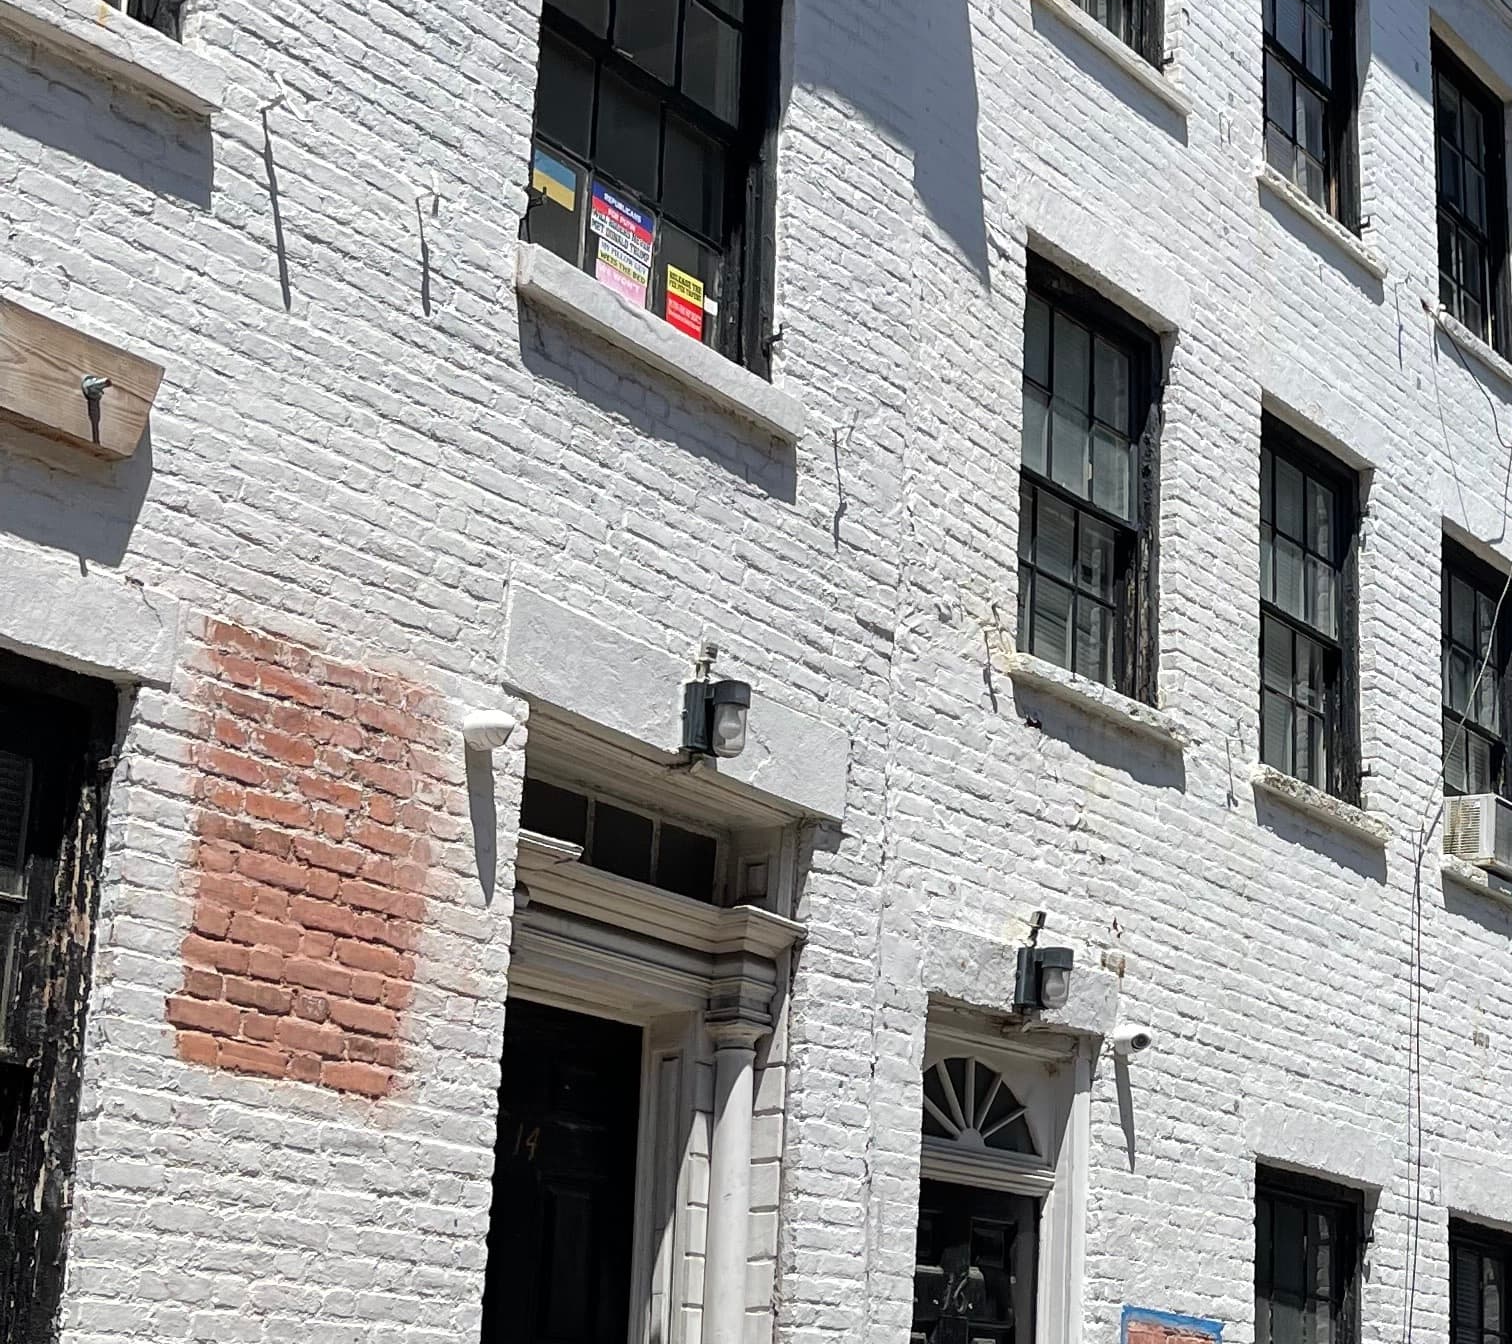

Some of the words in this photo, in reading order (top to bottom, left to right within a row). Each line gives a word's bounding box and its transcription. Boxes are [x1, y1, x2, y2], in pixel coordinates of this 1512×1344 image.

[604, 192, 642, 224] REPUBLICANS
[632, 271, 646, 285] BED
[512, 1120, 541, 1161] 14
